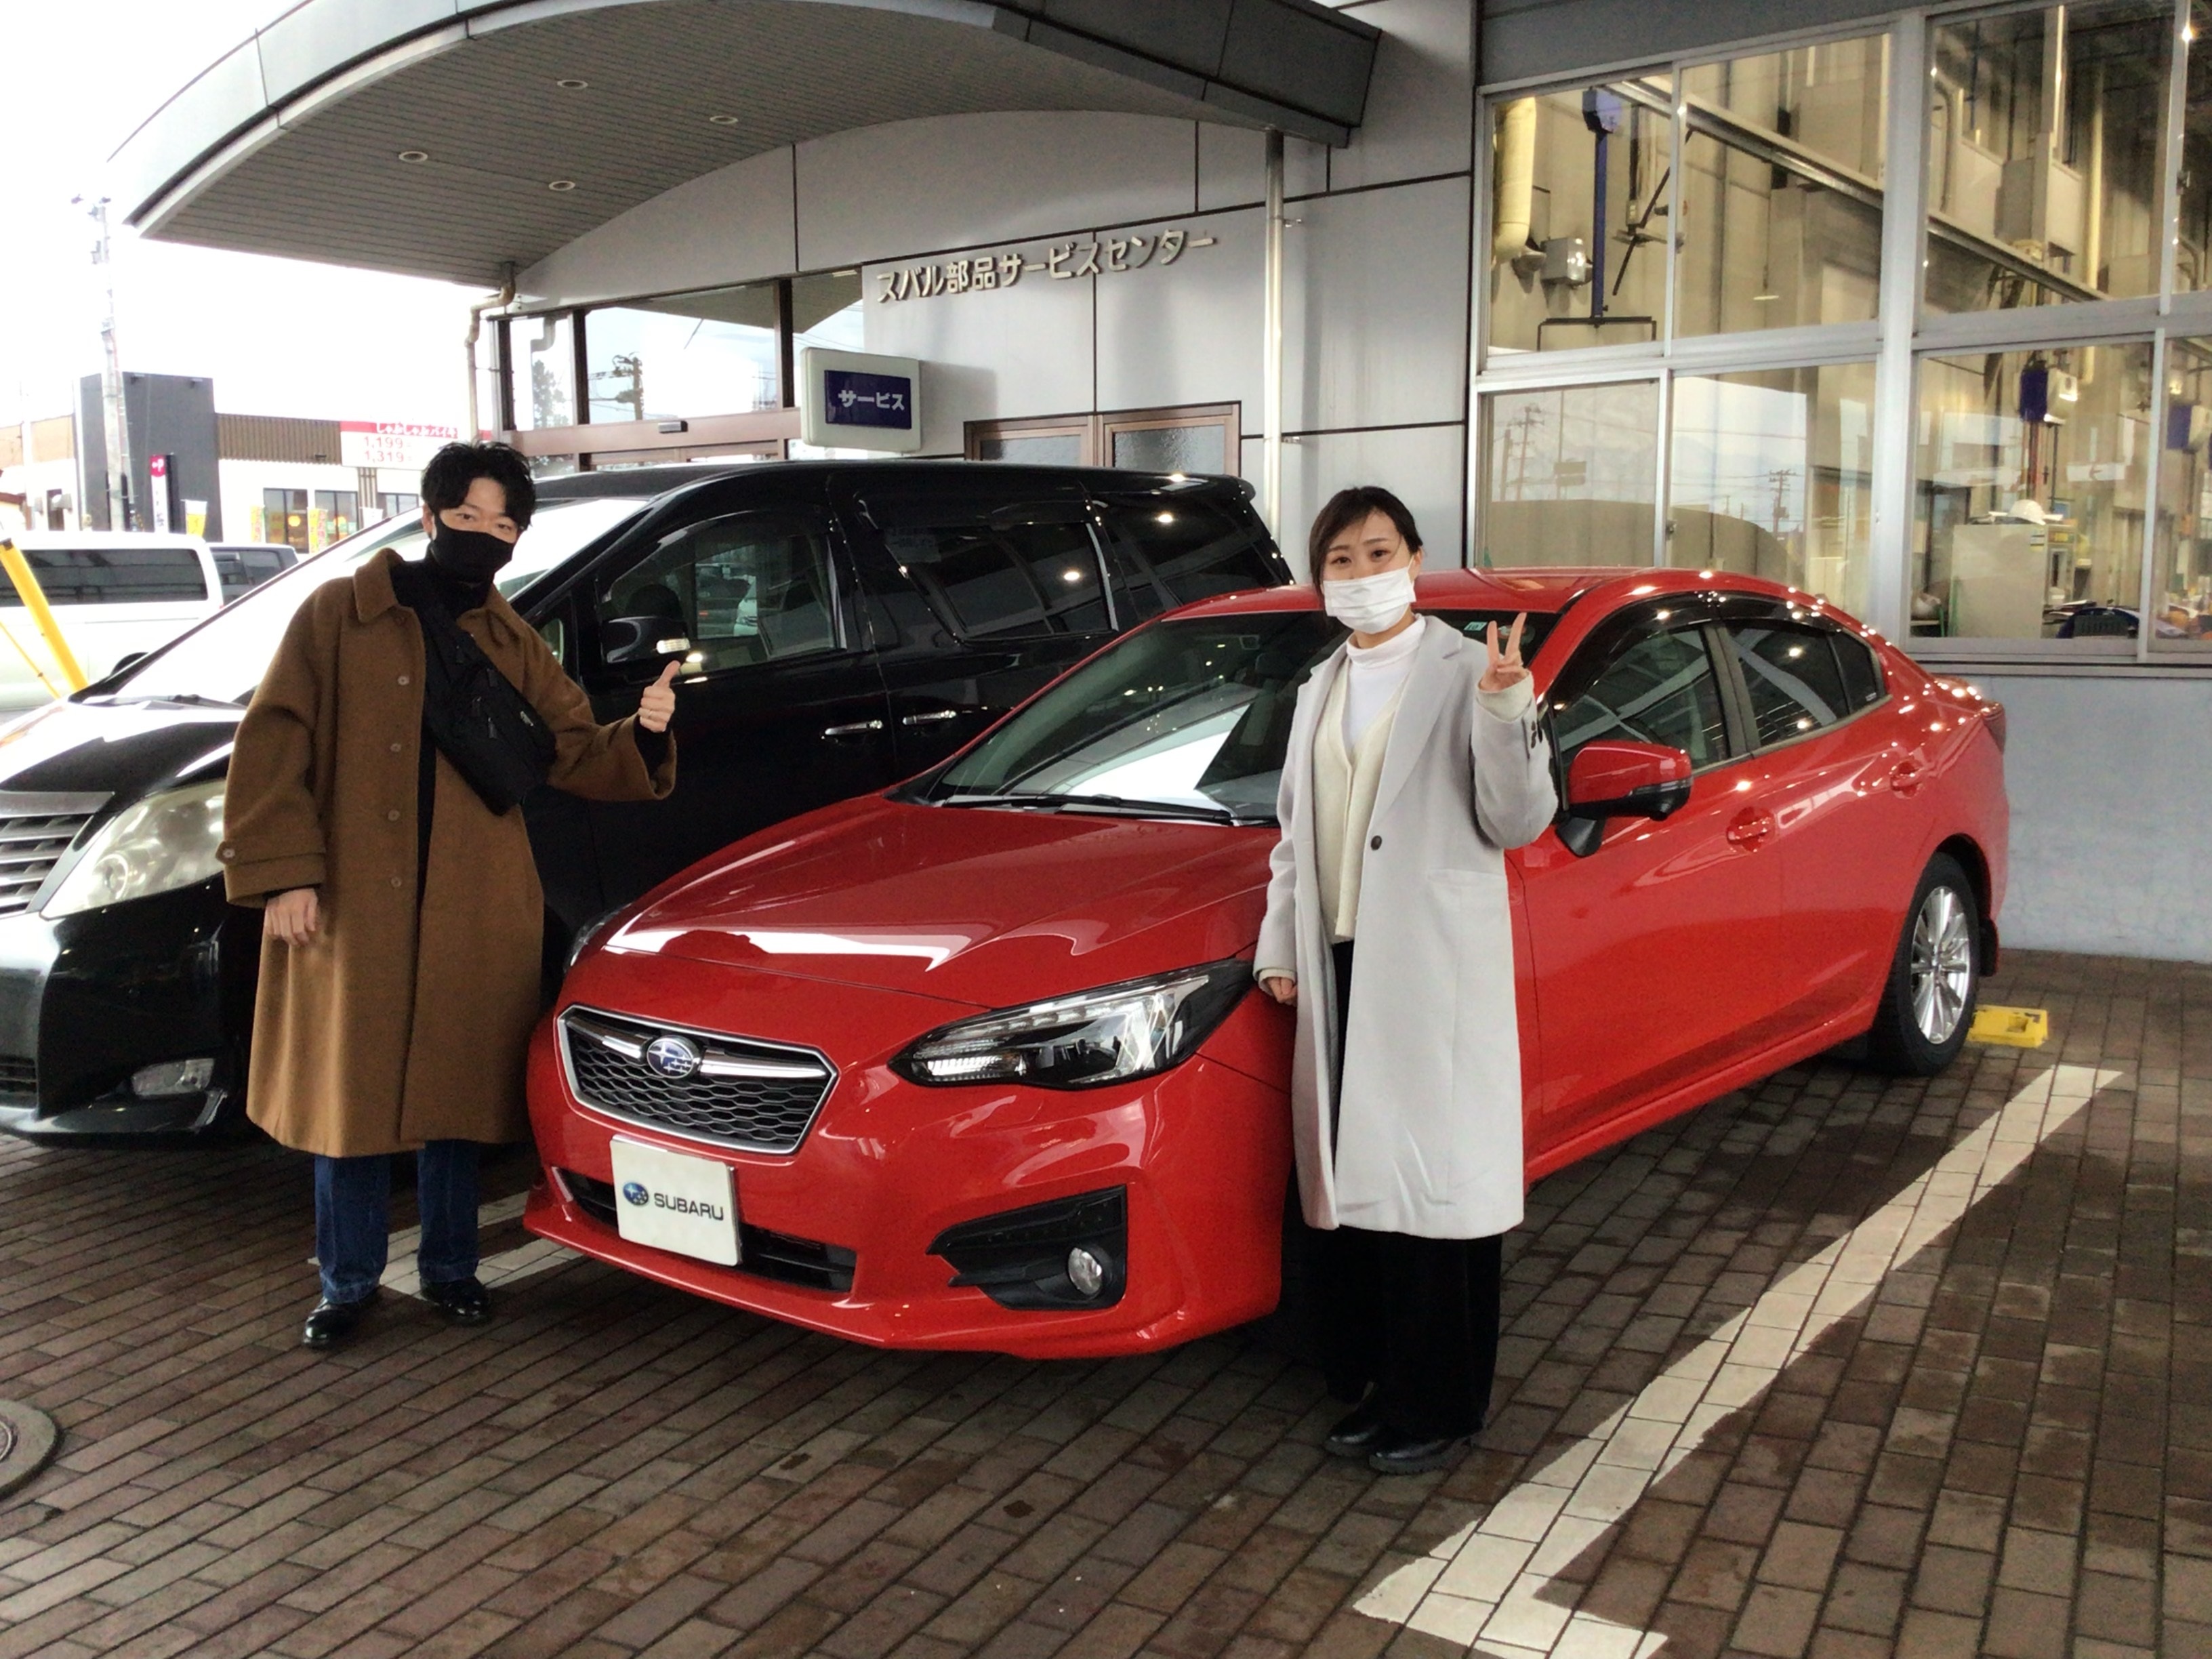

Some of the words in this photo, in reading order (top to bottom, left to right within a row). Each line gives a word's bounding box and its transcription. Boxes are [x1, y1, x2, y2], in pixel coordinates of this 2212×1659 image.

[877, 228, 1218, 304] スバル部品サービスセンター
[838, 389, 905, 411] サービス
[364, 436, 404, 449] 1,199
[364, 450, 405, 463] 1,319
[653, 1192, 724, 1221] SUBARU
